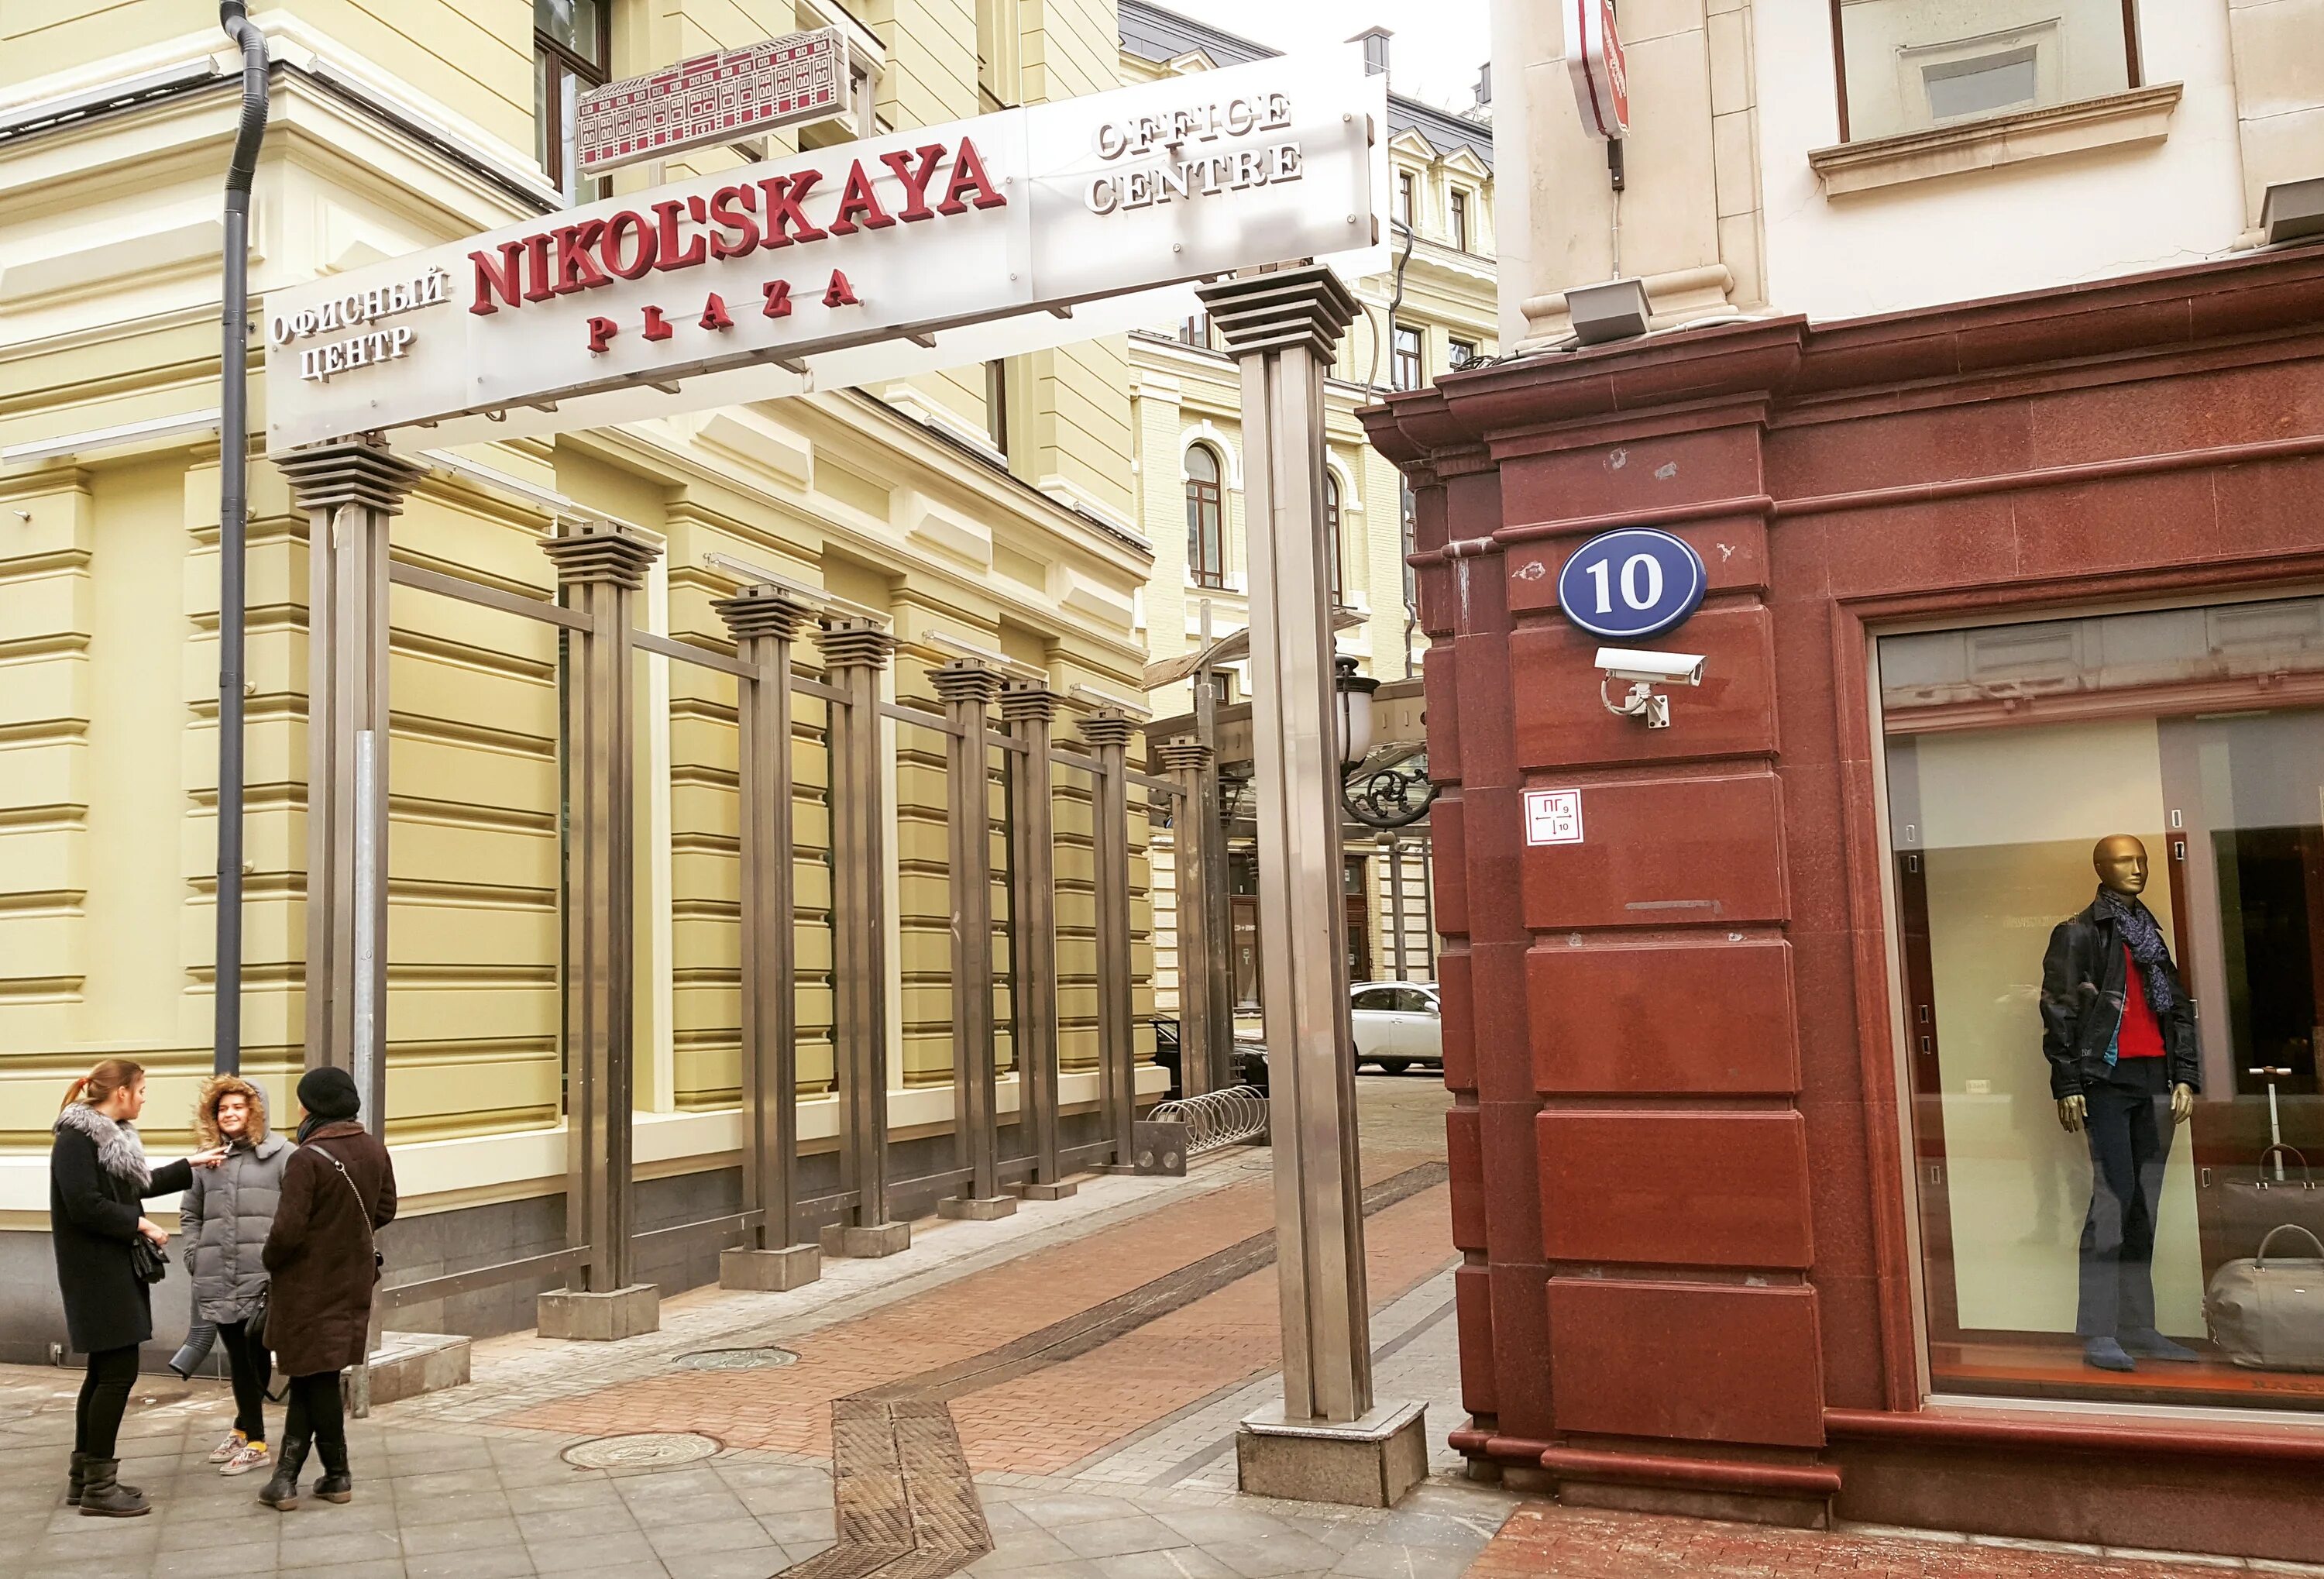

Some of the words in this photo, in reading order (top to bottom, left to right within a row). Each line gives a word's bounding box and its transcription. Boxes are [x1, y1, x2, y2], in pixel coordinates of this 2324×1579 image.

[1091, 90, 1291, 160] OFFICE
[1084, 141, 1303, 215] CENTRE
[468, 136, 1007, 316] NIKOL'SKAYA
[271, 263, 451, 346] ОФИСНЫЙ
[587, 268, 858, 353] PLAZA
[299, 325, 417, 383] ЦЕНТР
[1586, 553, 1663, 614] 10
[1544, 799, 1563, 812] ПГ
